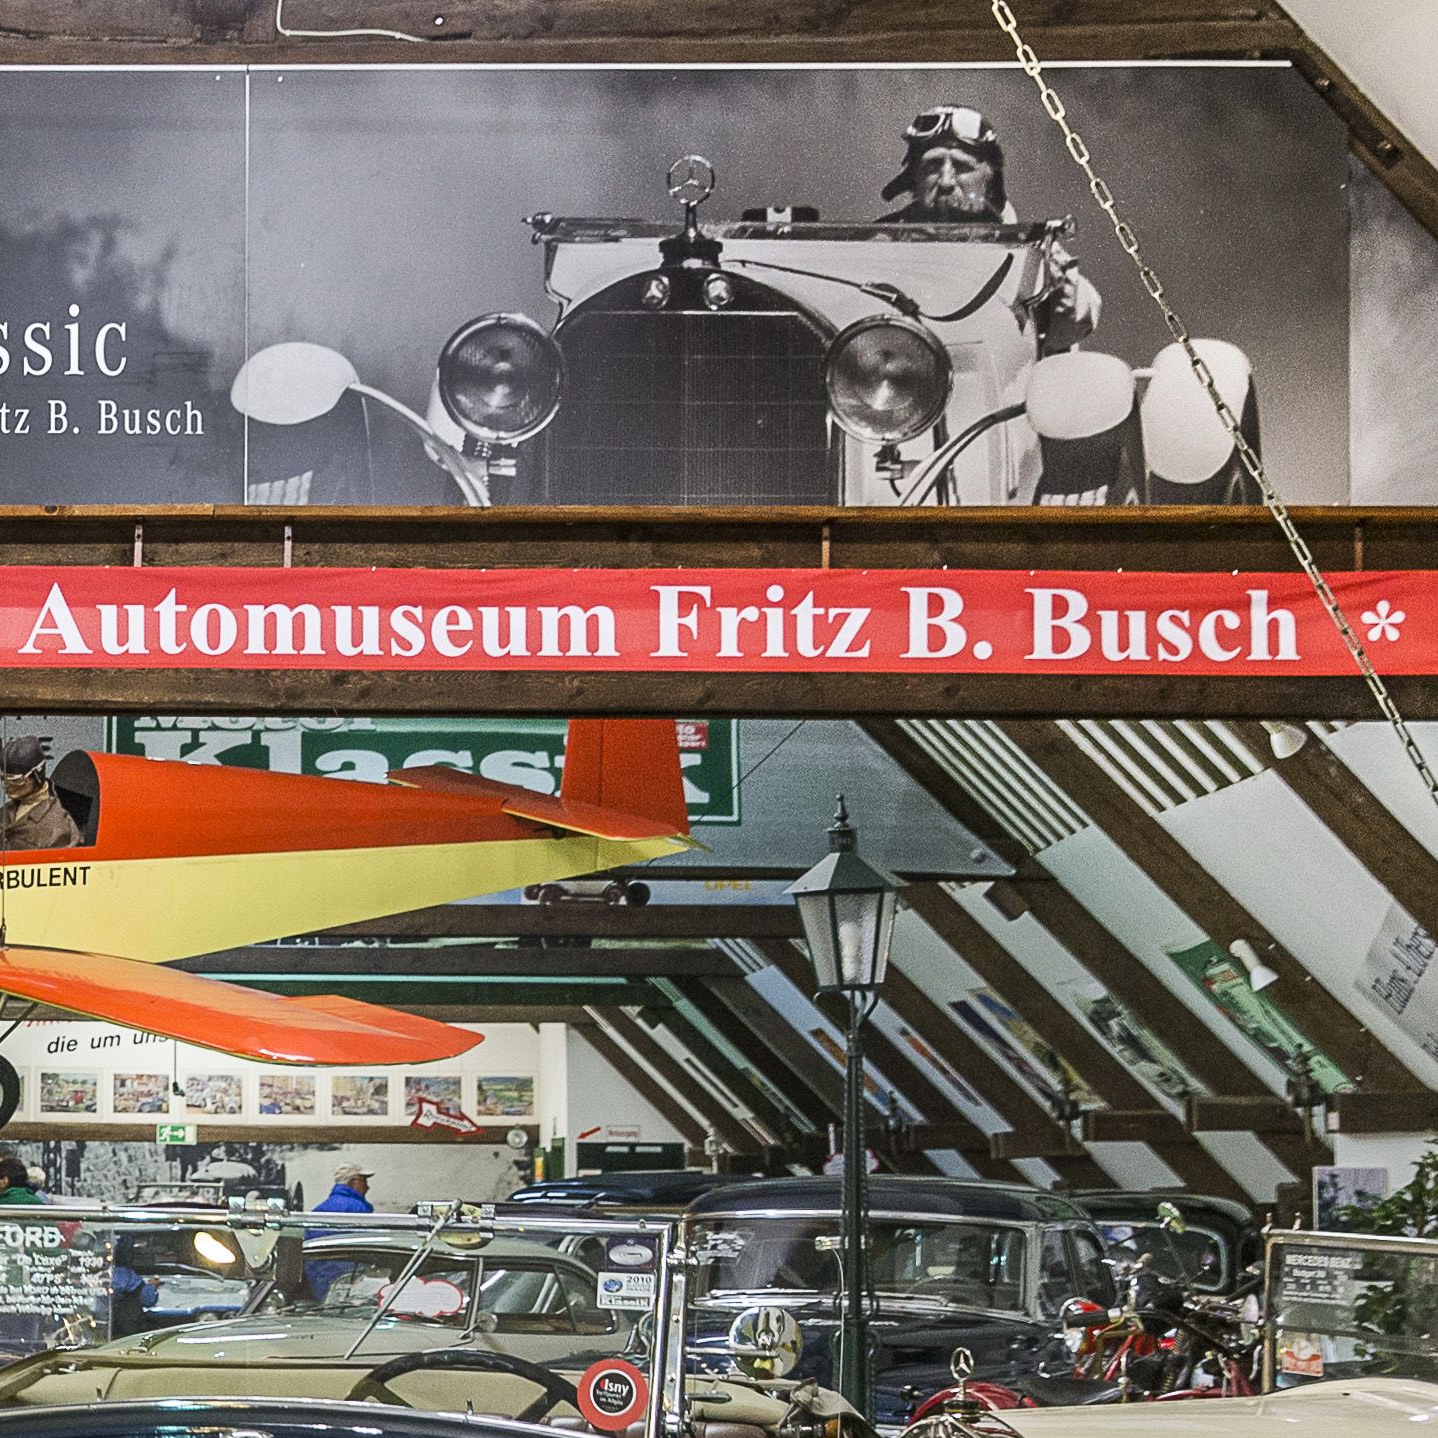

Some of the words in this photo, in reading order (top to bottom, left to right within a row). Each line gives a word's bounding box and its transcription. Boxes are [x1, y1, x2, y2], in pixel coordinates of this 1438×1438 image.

[46, 401, 83, 437] B.
[98, 399, 206, 437] Busch
[17, 580, 622, 659] Automuseum
[649, 584, 872, 661] Fritz
[898, 587, 993, 662] B.
[1023, 587, 1301, 664] Busch
[134, 729, 711, 804] Klassk
[47, 1036, 78, 1054] die
[90, 1034, 121, 1050] um
[626, 1275, 653, 1284] 2010
